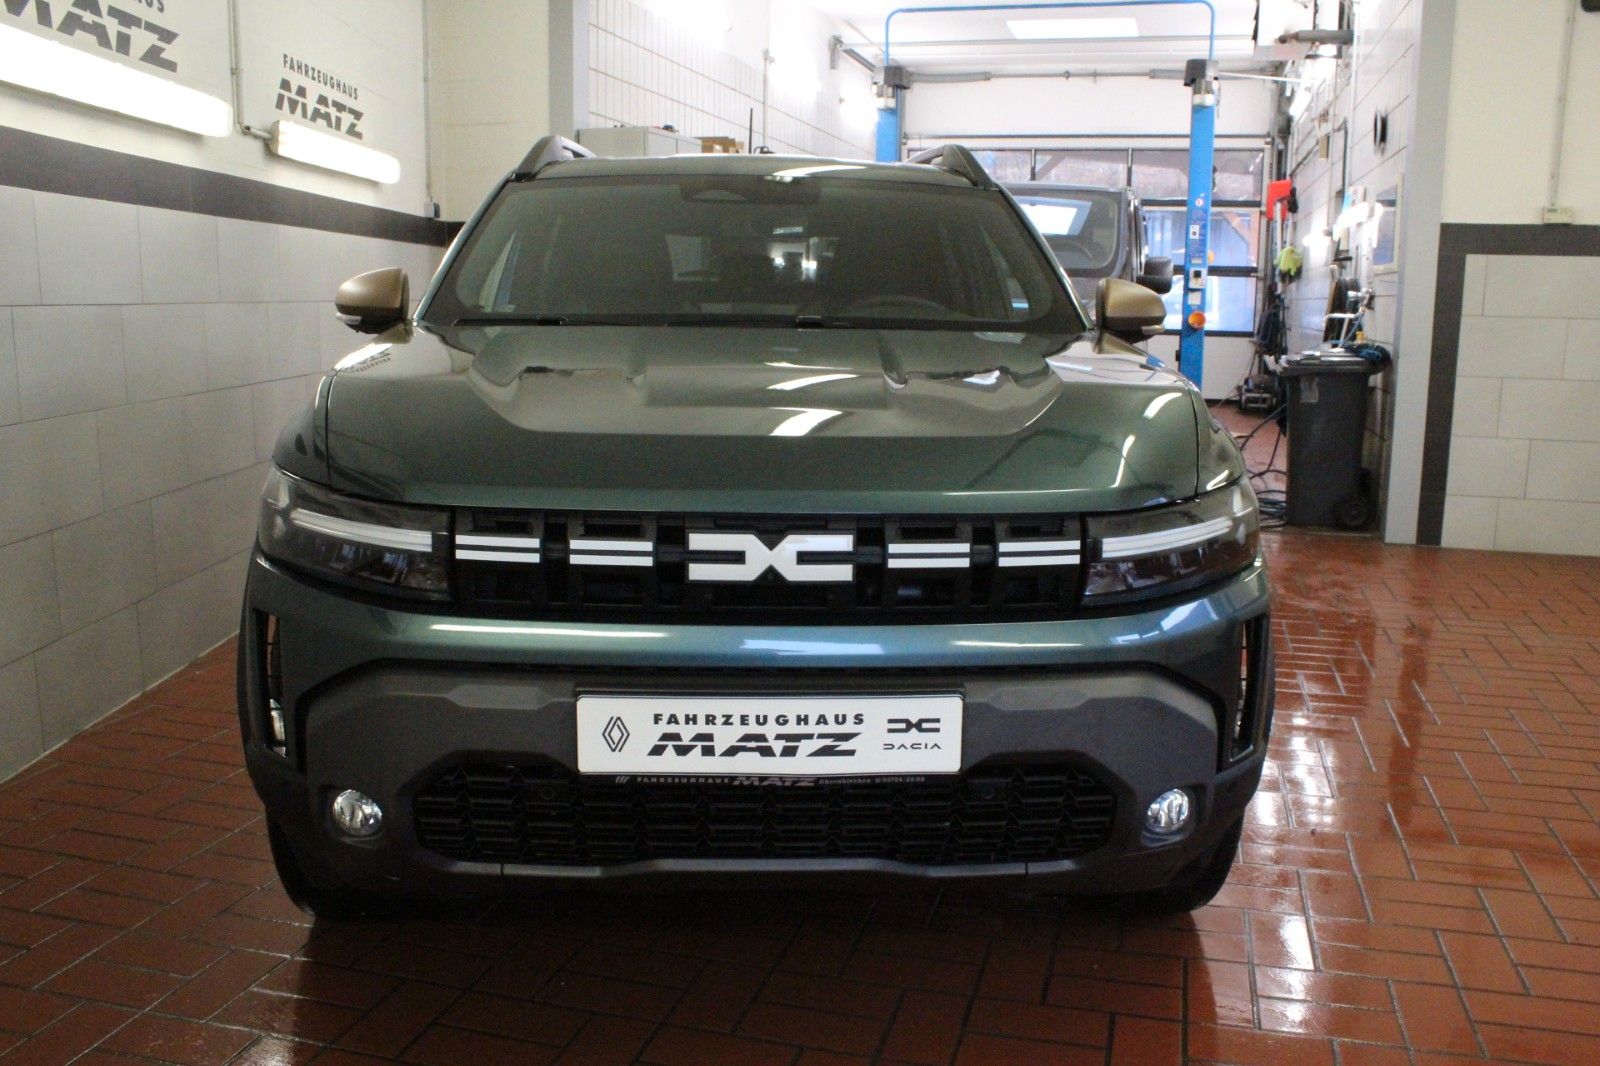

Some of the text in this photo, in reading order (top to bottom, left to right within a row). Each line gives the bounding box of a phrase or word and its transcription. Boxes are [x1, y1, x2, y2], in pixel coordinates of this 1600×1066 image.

[283, 53, 359, 101] FAHRZEUGHAUS
[275, 77, 364, 140] MATZ
[653, 713, 864, 726] FAHRZEUGHAUS
[647, 732, 862, 757] MATZ
